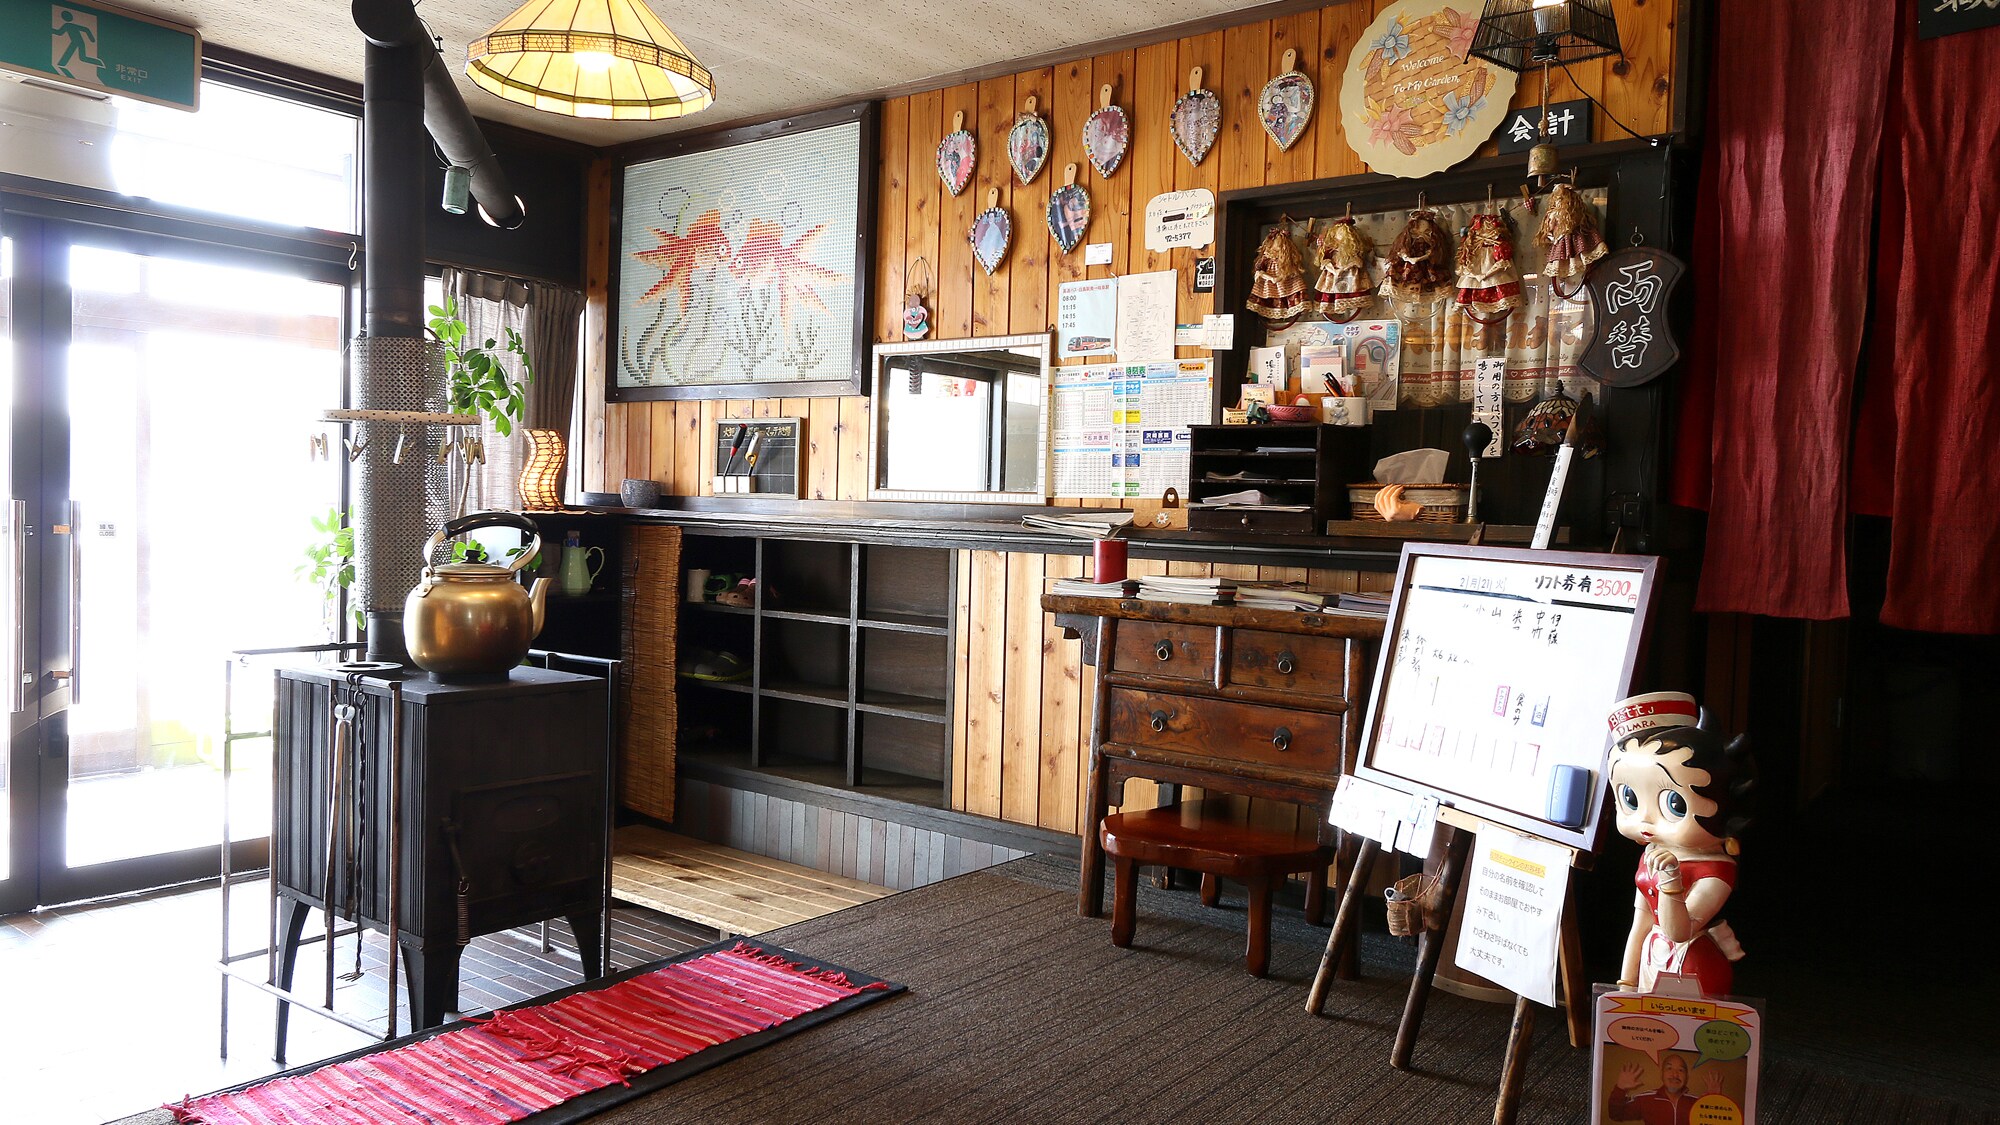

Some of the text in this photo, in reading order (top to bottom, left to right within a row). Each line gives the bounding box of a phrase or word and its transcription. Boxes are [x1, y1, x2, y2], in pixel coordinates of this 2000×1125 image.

[115, 64, 148, 79] 非常口
[1401, 55, 1444, 72] Welcome
[120, 73, 142, 84] EXIT
[1393, 83, 1404, 94] To
[1507, 108, 1575, 143] 会計
[1476, 361, 1488, 421] 鳴らして下
[1481, 866, 1545, 897] 自分の名前を確認して
[1479, 886, 1543, 917] そのままお部屋でおやす
[1473, 926, 1529, 957] わざわざ呼ばなくても
[1469, 947, 1506, 968] 大丈夫です。
[1651, 1003, 1706, 1015] いらっしゃいませ
